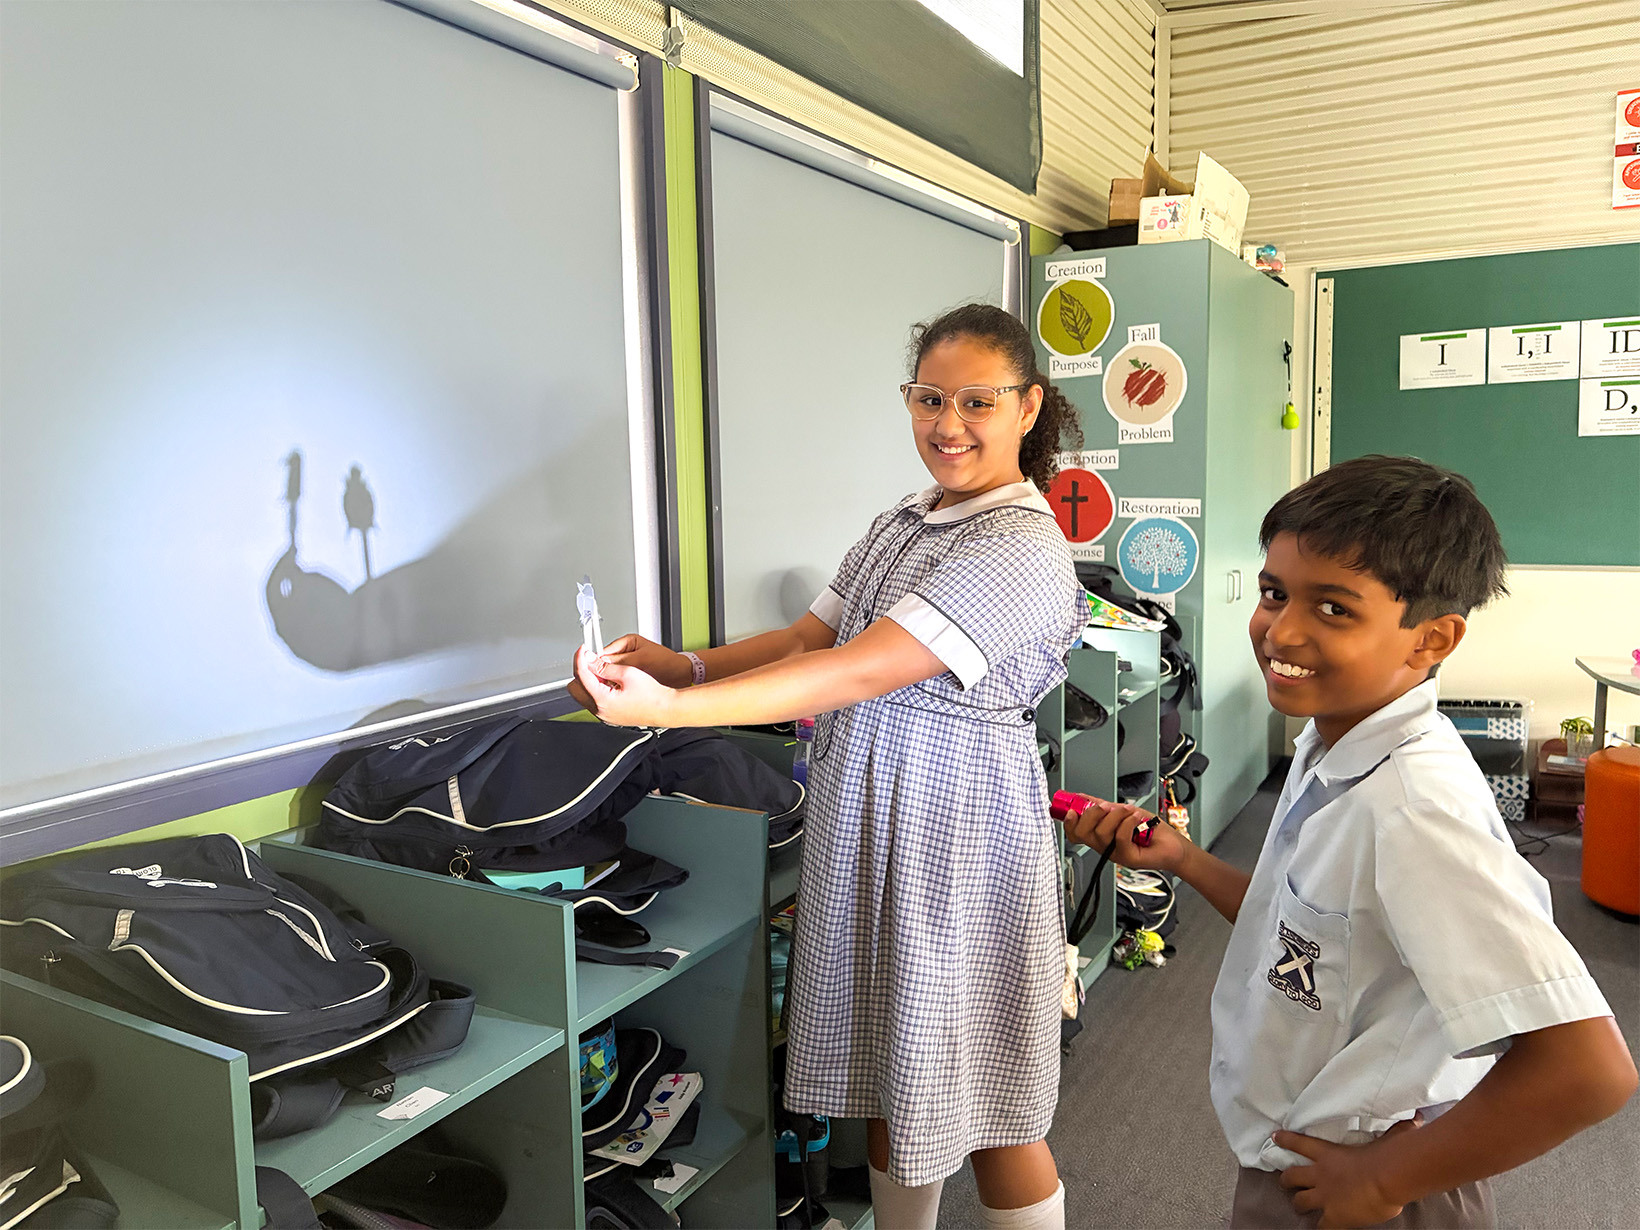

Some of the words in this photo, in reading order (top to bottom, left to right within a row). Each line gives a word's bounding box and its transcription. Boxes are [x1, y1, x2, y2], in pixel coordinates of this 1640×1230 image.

[1047, 261, 1103, 278] Creation
[1131, 327, 1156, 343] Fall
[1437, 343, 1448, 366] I
[1052, 358, 1099, 373] Purpose
[1120, 427, 1172, 441] Problem
[1121, 500, 1199, 515] Restoration
